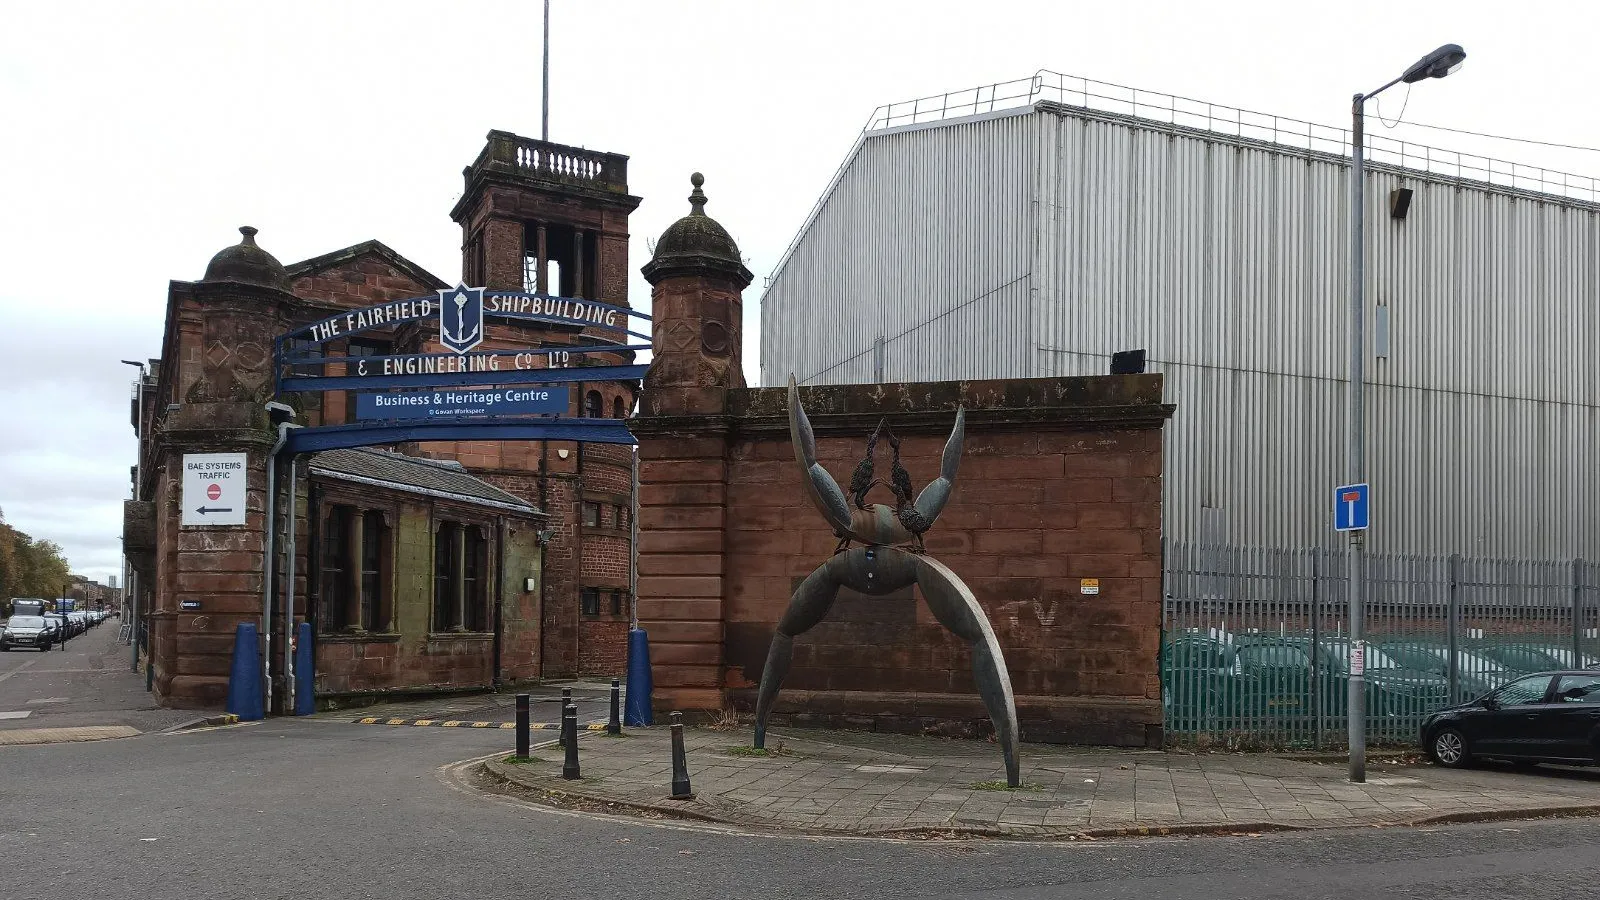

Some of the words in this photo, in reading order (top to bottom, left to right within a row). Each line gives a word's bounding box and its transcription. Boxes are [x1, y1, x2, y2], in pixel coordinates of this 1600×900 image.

[310, 319, 340, 341] THE
[346, 300, 431, 331] FAIRFIELD
[490, 295, 617, 326] SHIPBUILDING
[383, 354, 499, 375] ENGINEERING
[375, 394, 429, 406] Business
[433, 393, 442, 405] &
[446, 392, 501, 405] Heritage
[505, 390, 549, 402] Centre
